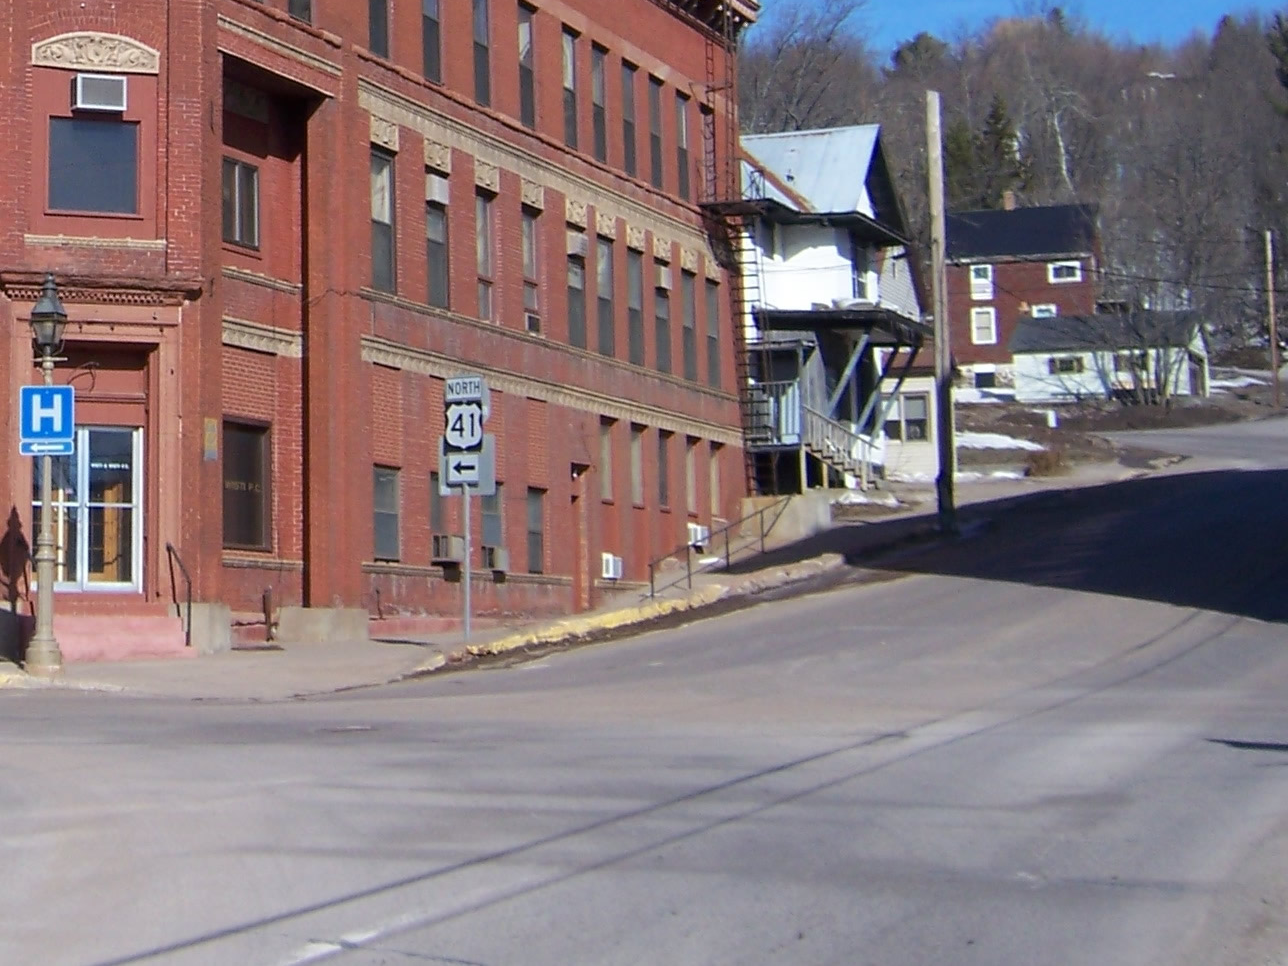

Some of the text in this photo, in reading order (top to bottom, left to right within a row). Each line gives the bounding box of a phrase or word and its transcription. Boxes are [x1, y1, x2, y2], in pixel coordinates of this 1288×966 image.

[447, 381, 481, 395] NORTH
[32, 394, 62, 432] H
[450, 413, 475, 438] 41
